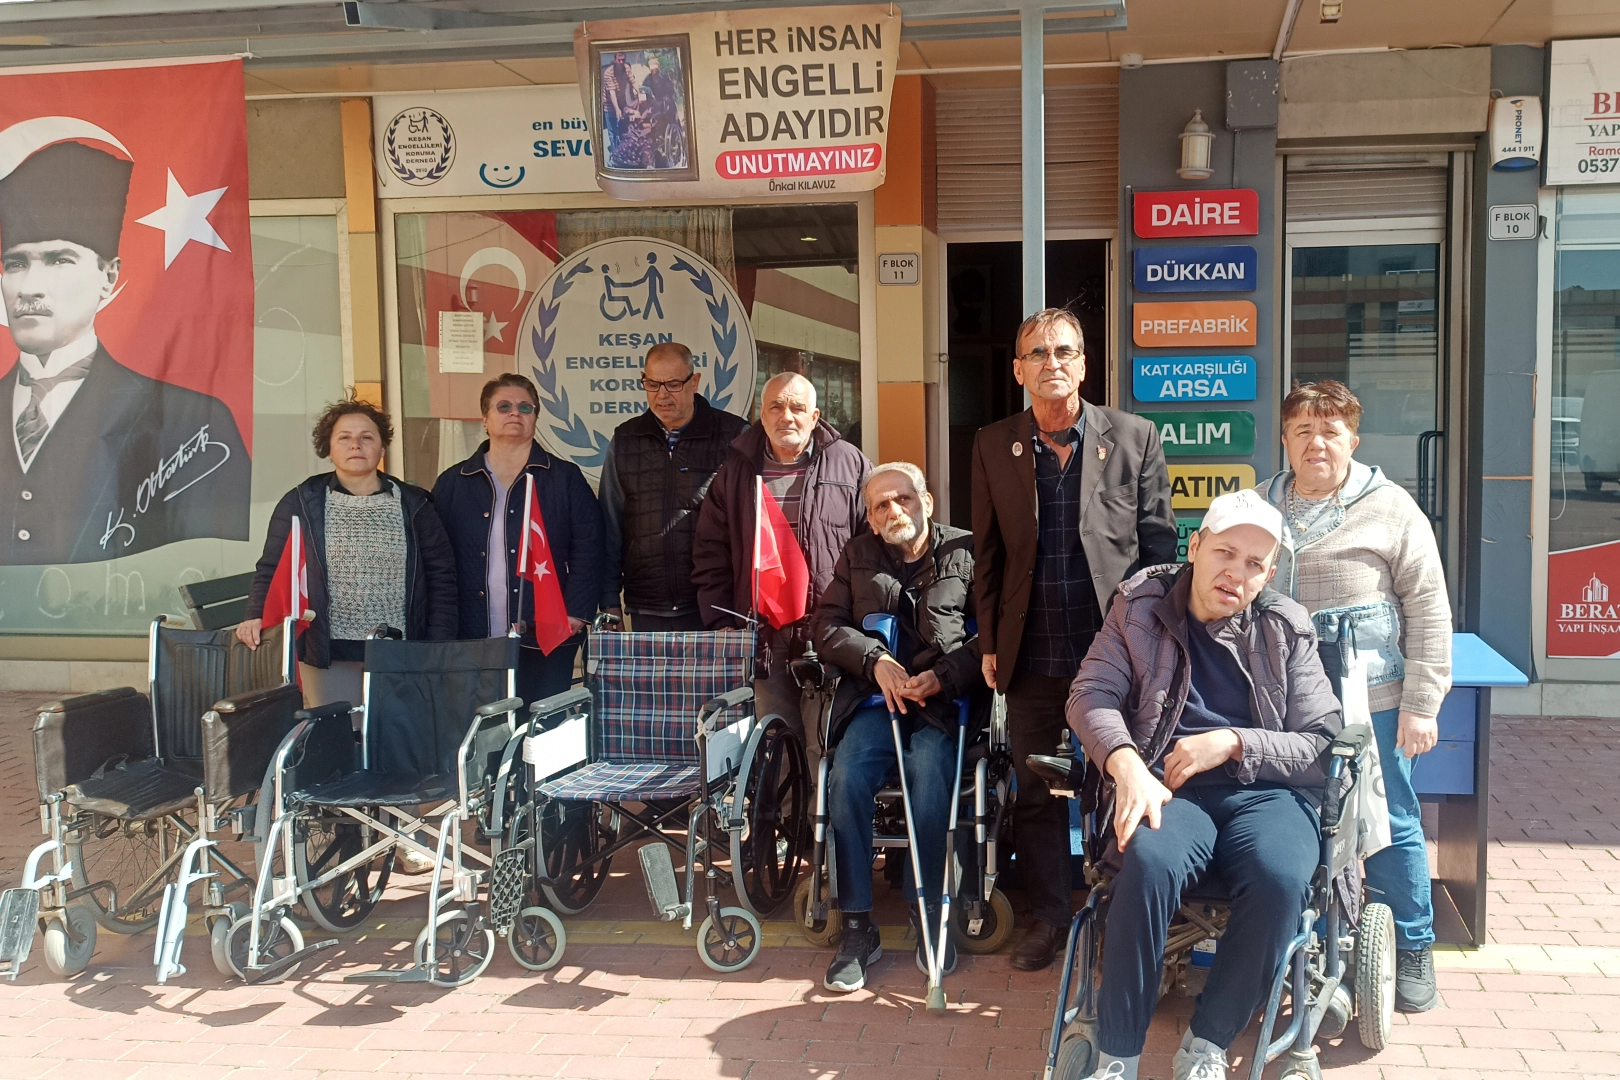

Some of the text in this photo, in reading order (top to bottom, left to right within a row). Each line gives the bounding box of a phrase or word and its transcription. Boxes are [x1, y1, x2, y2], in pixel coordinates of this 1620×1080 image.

[714, 28, 779, 57] HER
[532, 121, 553, 131] en
[719, 105, 885, 143] ADAYIDIR
[1514, 109, 1523, 145] PRONET
[398, 142, 443, 150] ENGELLİLERİ
[725, 147, 875, 175] UNUTMAYINIZ
[1577, 157, 1620, 174] 0537
[768, 178, 836, 192] Önkal KILAVUZ
[1151, 197, 1240, 226] DAİRE
[1495, 212, 1531, 222] F BLOK
[1506, 224, 1520, 234] 10
[883, 259, 914, 268] F BLOK
[1146, 260, 1245, 282] DÜKKAN
[893, 270, 904, 280] 11
[1140, 314, 1249, 335] PREFABRİK
[598, 332, 673, 350] KEŞAN
[1141, 359, 1247, 379] KAT KARŞILIĞI
[590, 378, 646, 392] KORU
[1159, 379, 1228, 398] ARSA
[590, 401, 649, 415] DERN
[1159, 422, 1231, 445] ALIM
[1171, 476, 1240, 498] ATIM
[1560, 603, 1620, 619] BERA
[1557, 623, 1585, 633] YAPI
